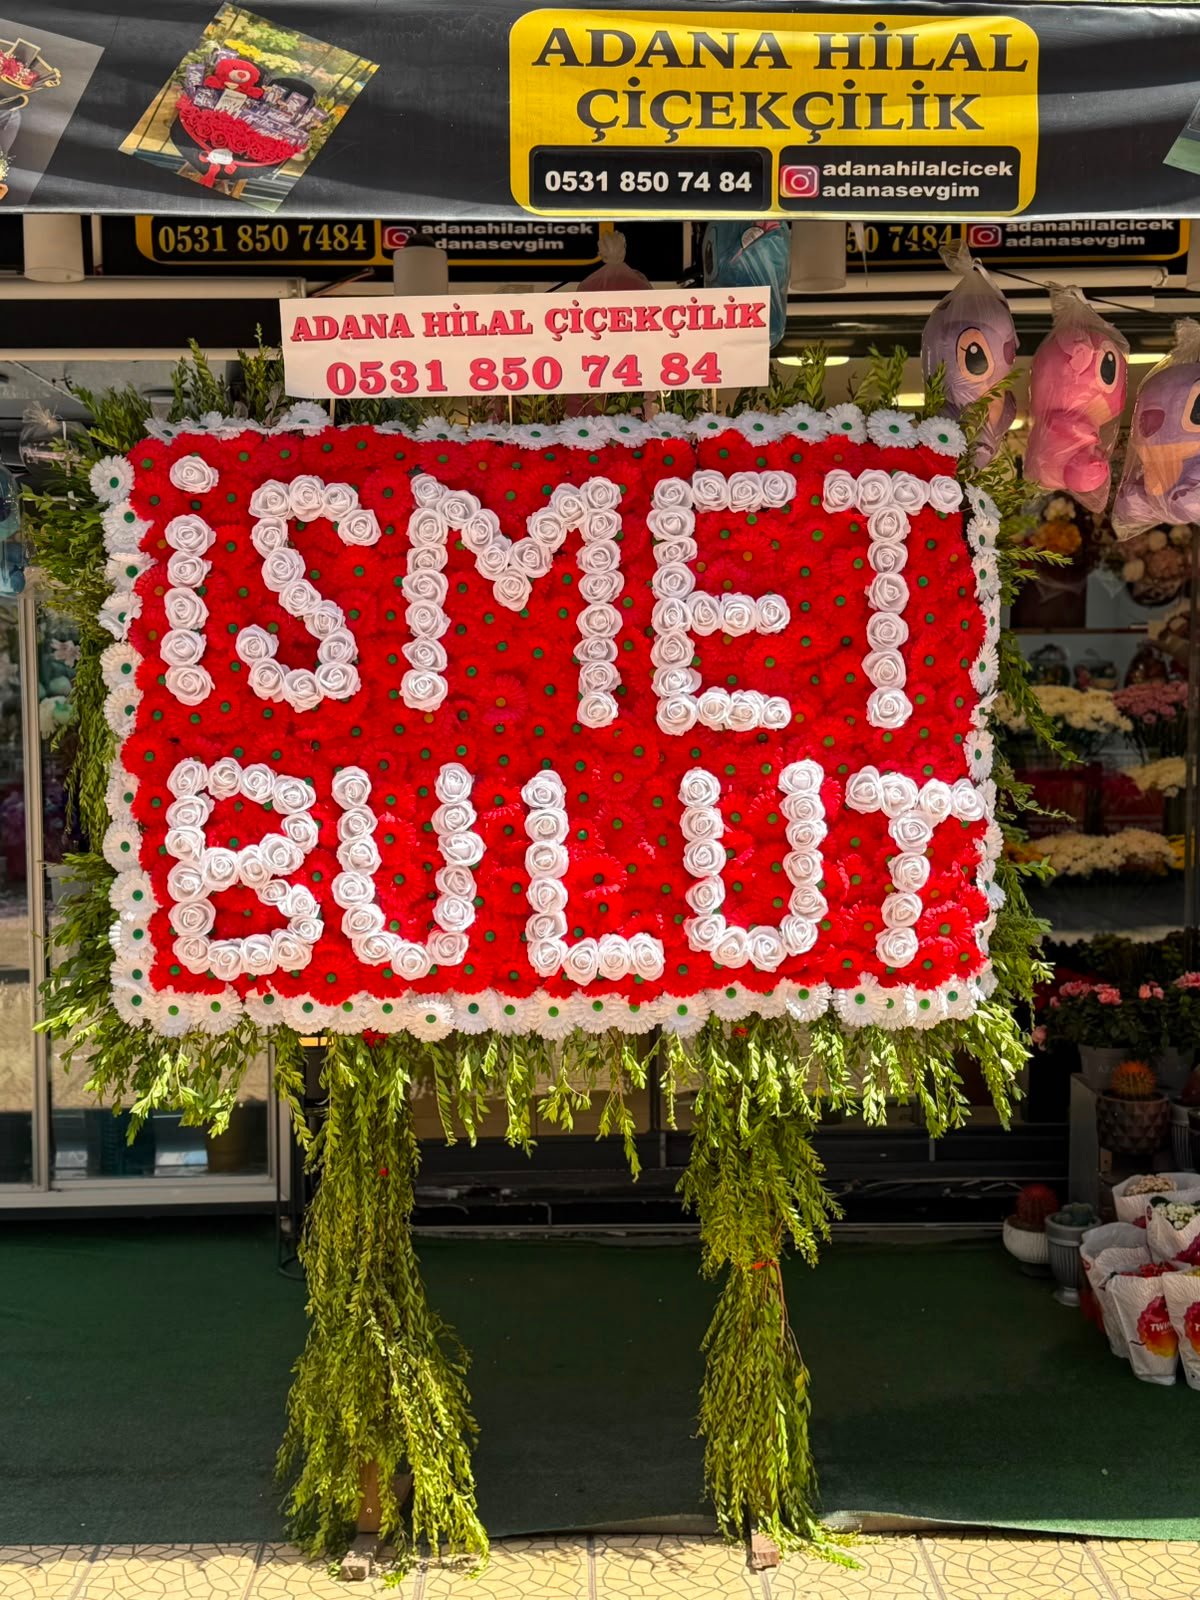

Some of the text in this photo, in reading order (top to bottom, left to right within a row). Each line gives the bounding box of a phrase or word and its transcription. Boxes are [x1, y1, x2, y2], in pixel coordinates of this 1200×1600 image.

[531, 21, 1028, 73] ADANA HİLAL
[576, 77, 985, 144] ÇİÇEKÇİLİK
[822, 160, 1013, 178] adanahilalcicek
[544, 170, 753, 193] 0531 850 74 84
[822, 182, 980, 202] adanasevgim
[421, 222, 594, 236] adanahilalcicek
[1005, 219, 1175, 232] adanahilalcicek
[158, 223, 367, 253] 0531 850 7484
[434, 238, 564, 252] danasevgim
[1005, 234, 1146, 248] adanasevgim
[290, 296, 767, 342] ADANA HİLAL ÇİÇEKÇİLİK
[326, 352, 722, 396] 0531 850 74 84
[163, 757, 987, 985] BULUT
